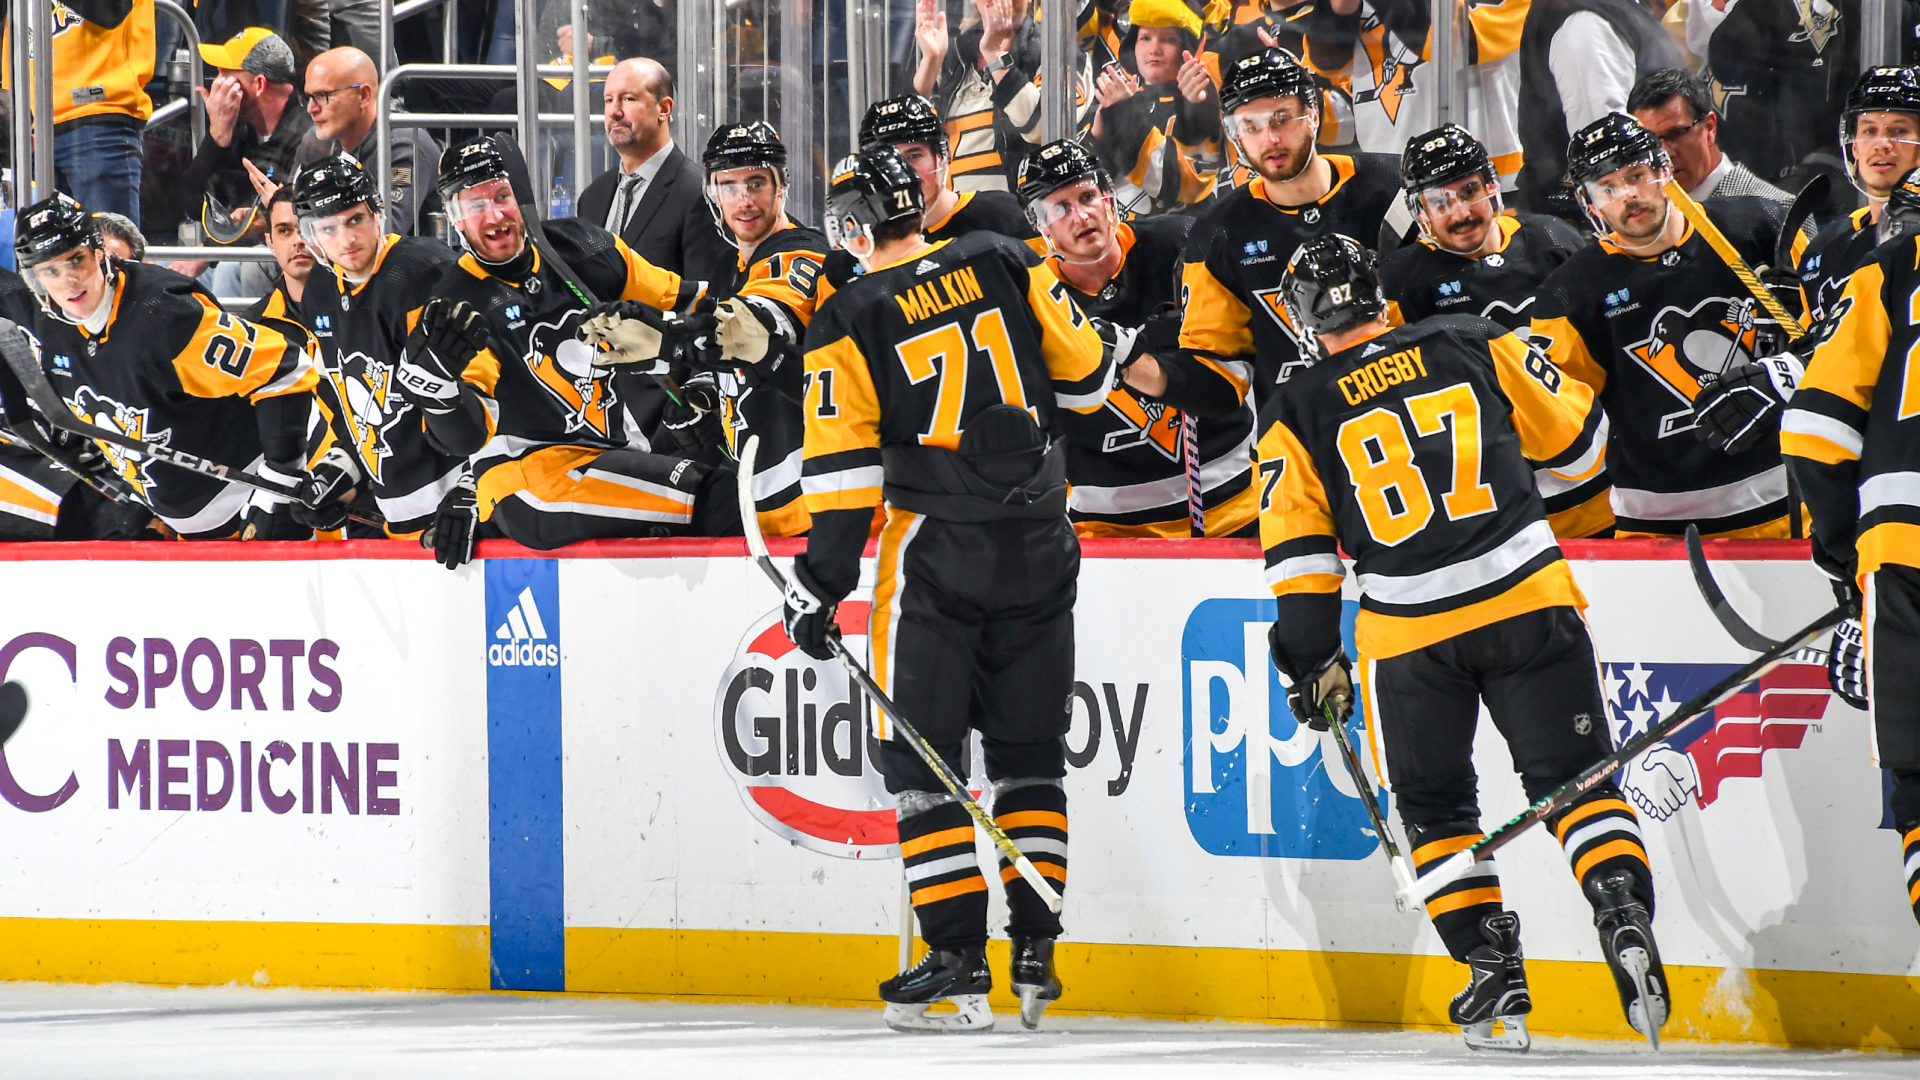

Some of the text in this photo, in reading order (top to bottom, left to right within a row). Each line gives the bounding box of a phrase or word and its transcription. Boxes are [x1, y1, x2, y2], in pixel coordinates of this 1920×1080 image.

[1240, 73, 1270, 88] CCM
[1867, 86, 1901, 94] CCM
[880, 103, 900, 116] 10
[728, 127, 748, 139] 19
[878, 121, 908, 133] CCM
[1586, 127, 1605, 145] 17
[1589, 145, 1619, 165] CCM
[1431, 161, 1456, 175] CCM
[315, 193, 341, 207] CCM
[893, 189, 914, 209] 71
[35, 234, 61, 250] CCM
[1243, 255, 1276, 266] HIGHMARK
[894, 266, 984, 325] MALKIN
[1329, 282, 1353, 305] 87
[895, 308, 1041, 452] 71
[1337, 346, 1428, 406] CROSBY
[147, 443, 229, 479] CCM
[1336, 382, 1498, 547] 87
[489, 638, 559, 667] adidas
[104, 636, 342, 713] SPORTS
[1811, 724, 1823, 734] TM
[107, 738, 400, 815] MEDICINE
[1584, 759, 1619, 789] BAUER
